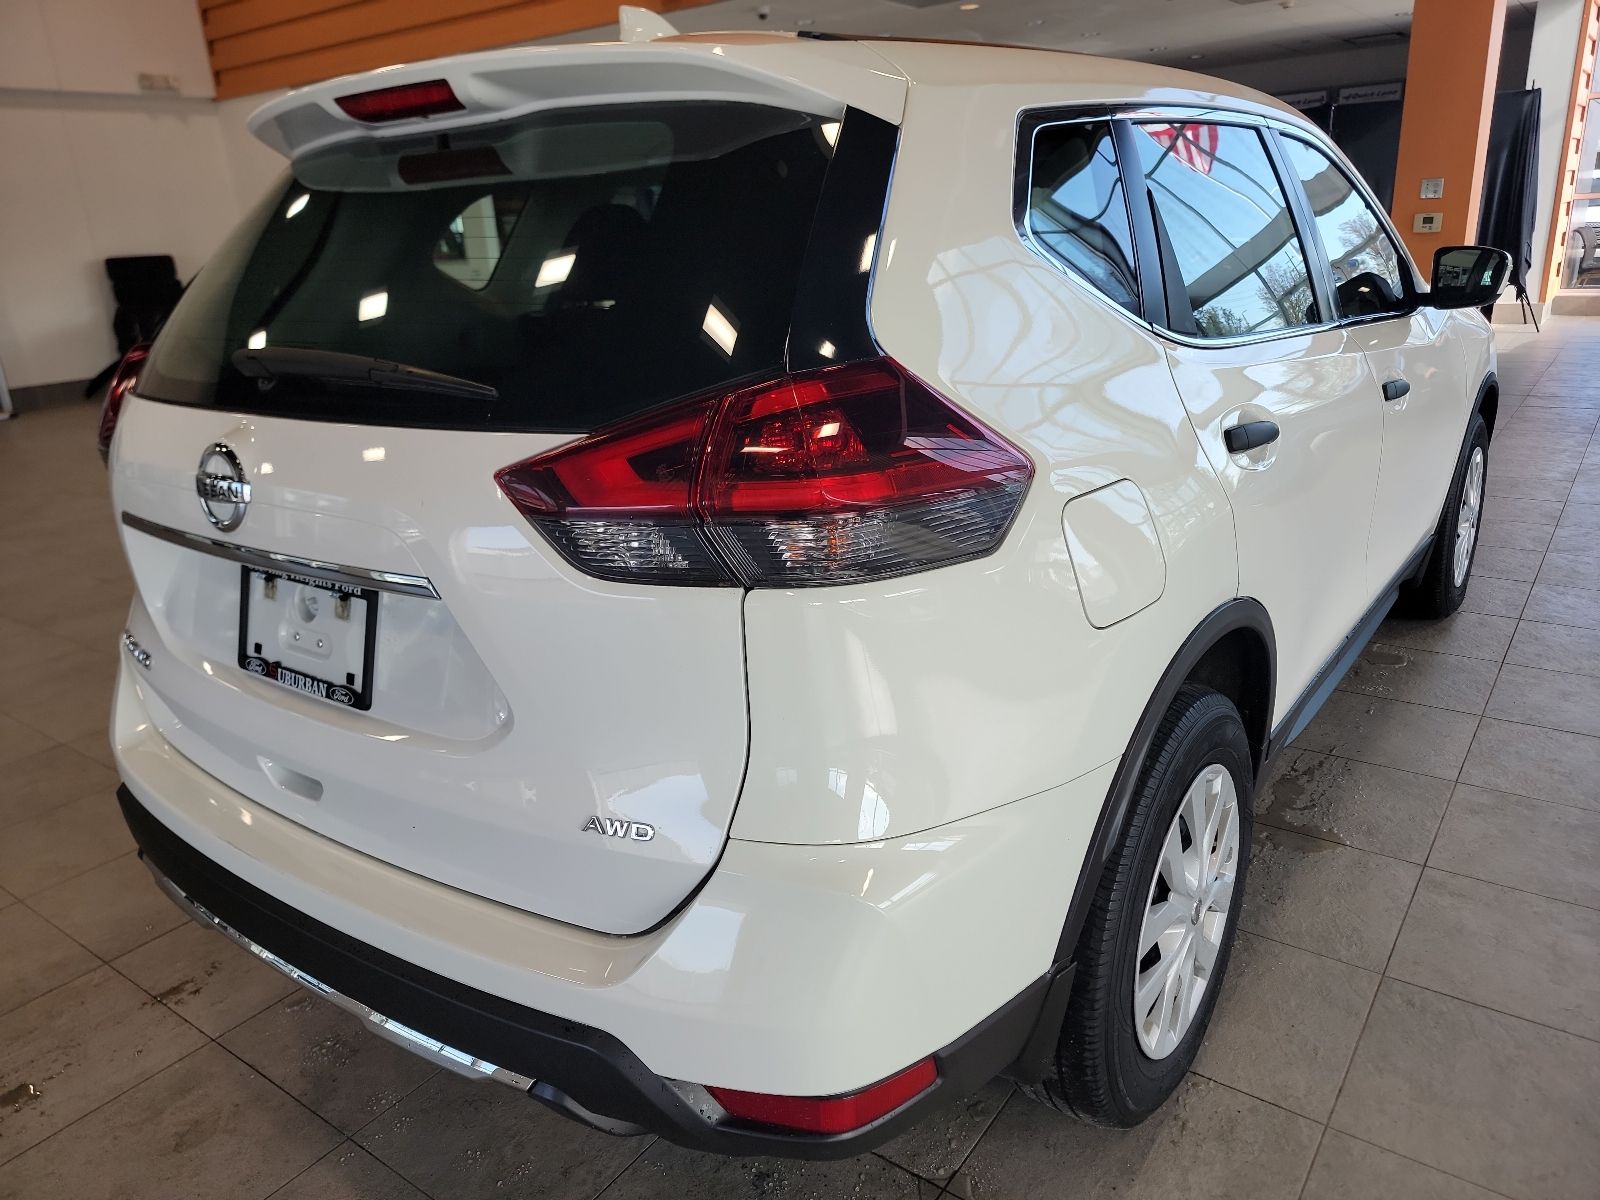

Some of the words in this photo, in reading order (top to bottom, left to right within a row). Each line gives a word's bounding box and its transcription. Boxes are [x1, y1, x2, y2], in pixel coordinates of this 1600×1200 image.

[335, 582, 361, 595] Ford
[269, 663, 328, 698] SUBURBAN
[581, 815, 655, 842] AWD
